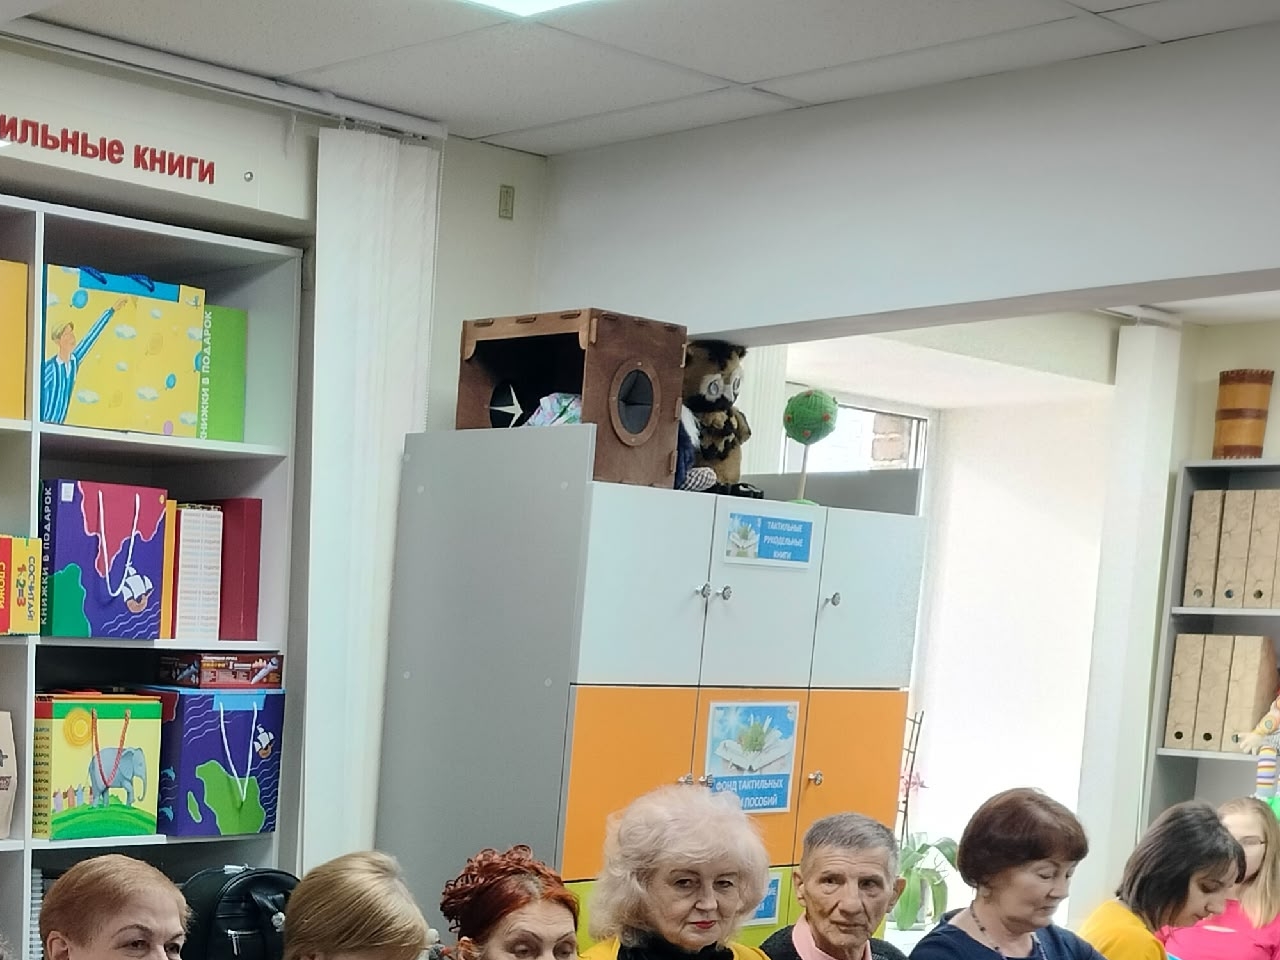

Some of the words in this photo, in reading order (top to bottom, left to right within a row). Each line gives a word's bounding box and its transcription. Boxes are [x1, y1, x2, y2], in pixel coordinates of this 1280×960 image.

[133, 143, 216, 185] книги
[202, 311, 212, 373] ПОДАРОК
[202, 376, 210, 385] В
[43, 487, 52, 550] ПОДАРОК
[767, 521, 803, 533] ТАКТИЛЬНЫЕ
[43, 554, 50, 562] В
[773, 551, 792, 560] КНИГИ
[40, 567, 49, 625] КНИЖКИ
[716, 781, 737, 792] ФОНД
[738, 779, 783, 790] ТАКТИЛЬНЫХ
[744, 796, 778, 807] ПОСОБИЙ
